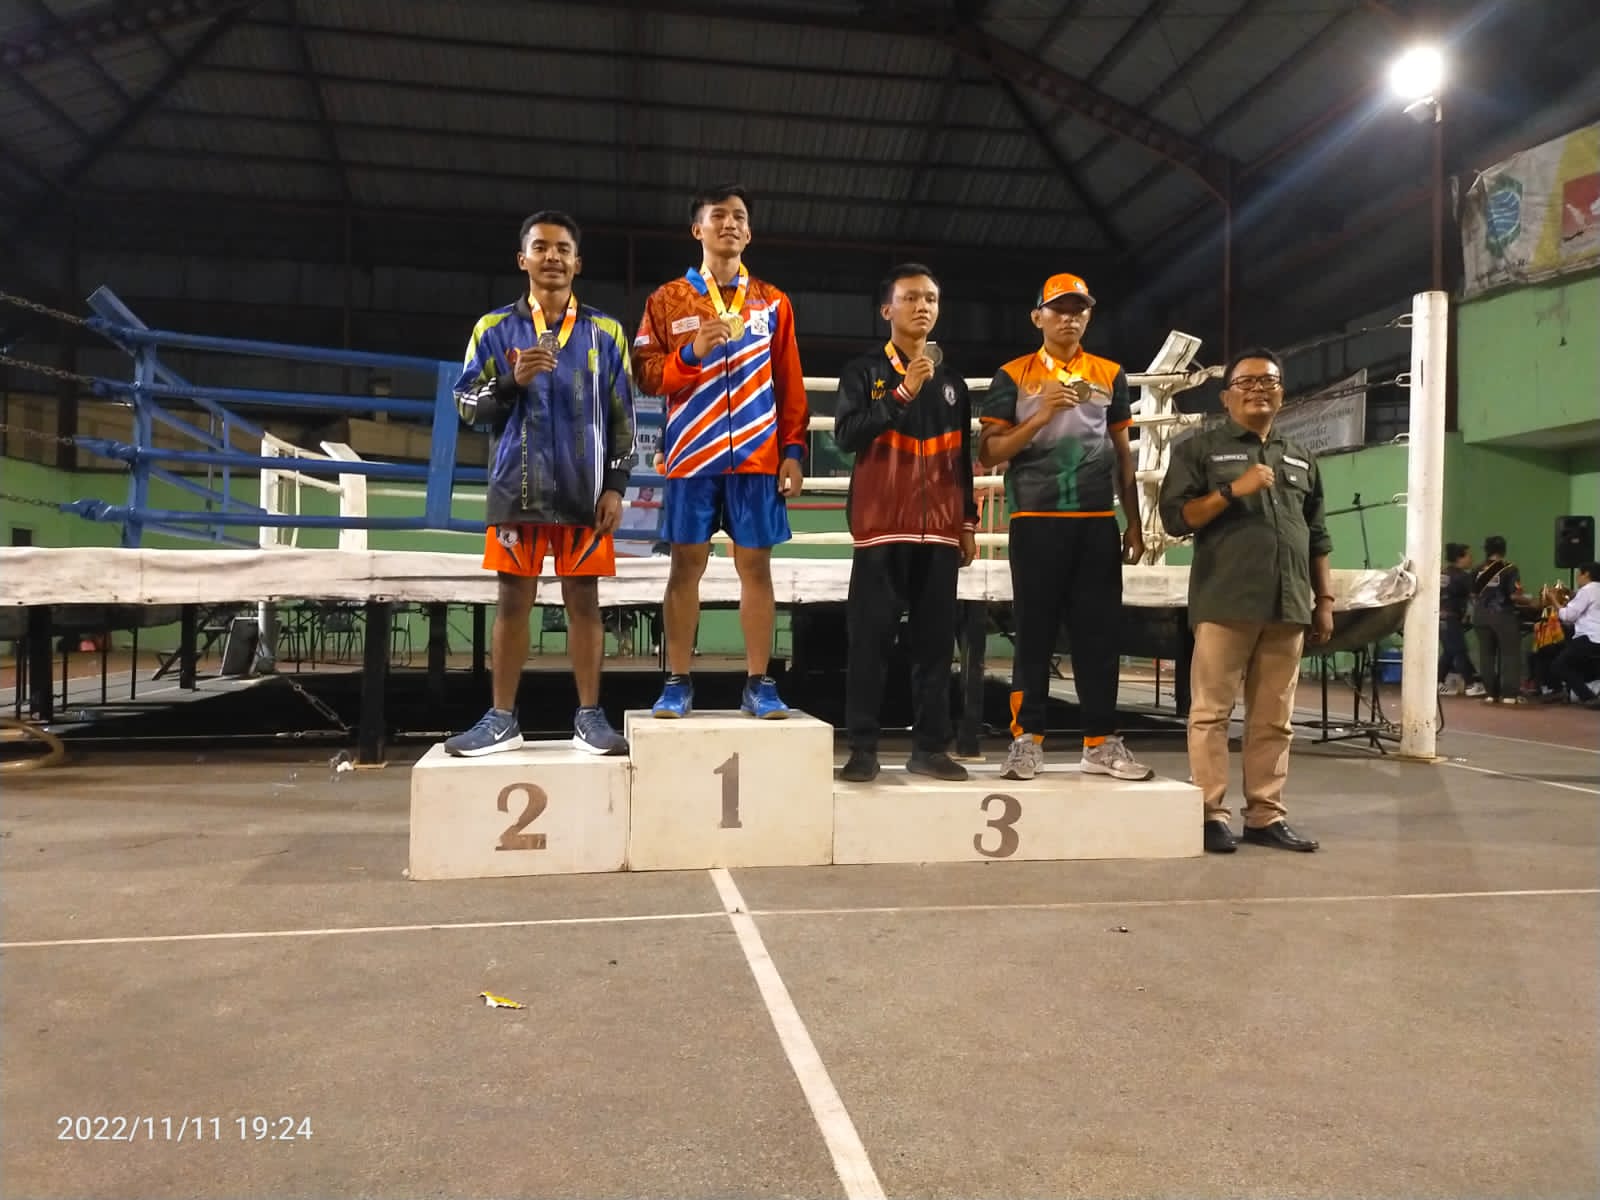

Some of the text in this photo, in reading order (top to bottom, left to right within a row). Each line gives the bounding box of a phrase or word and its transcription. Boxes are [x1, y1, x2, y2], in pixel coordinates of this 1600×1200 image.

[495, 782, 548, 851] 2
[713, 752, 742, 828] 1
[973, 793, 1022, 858] 3
